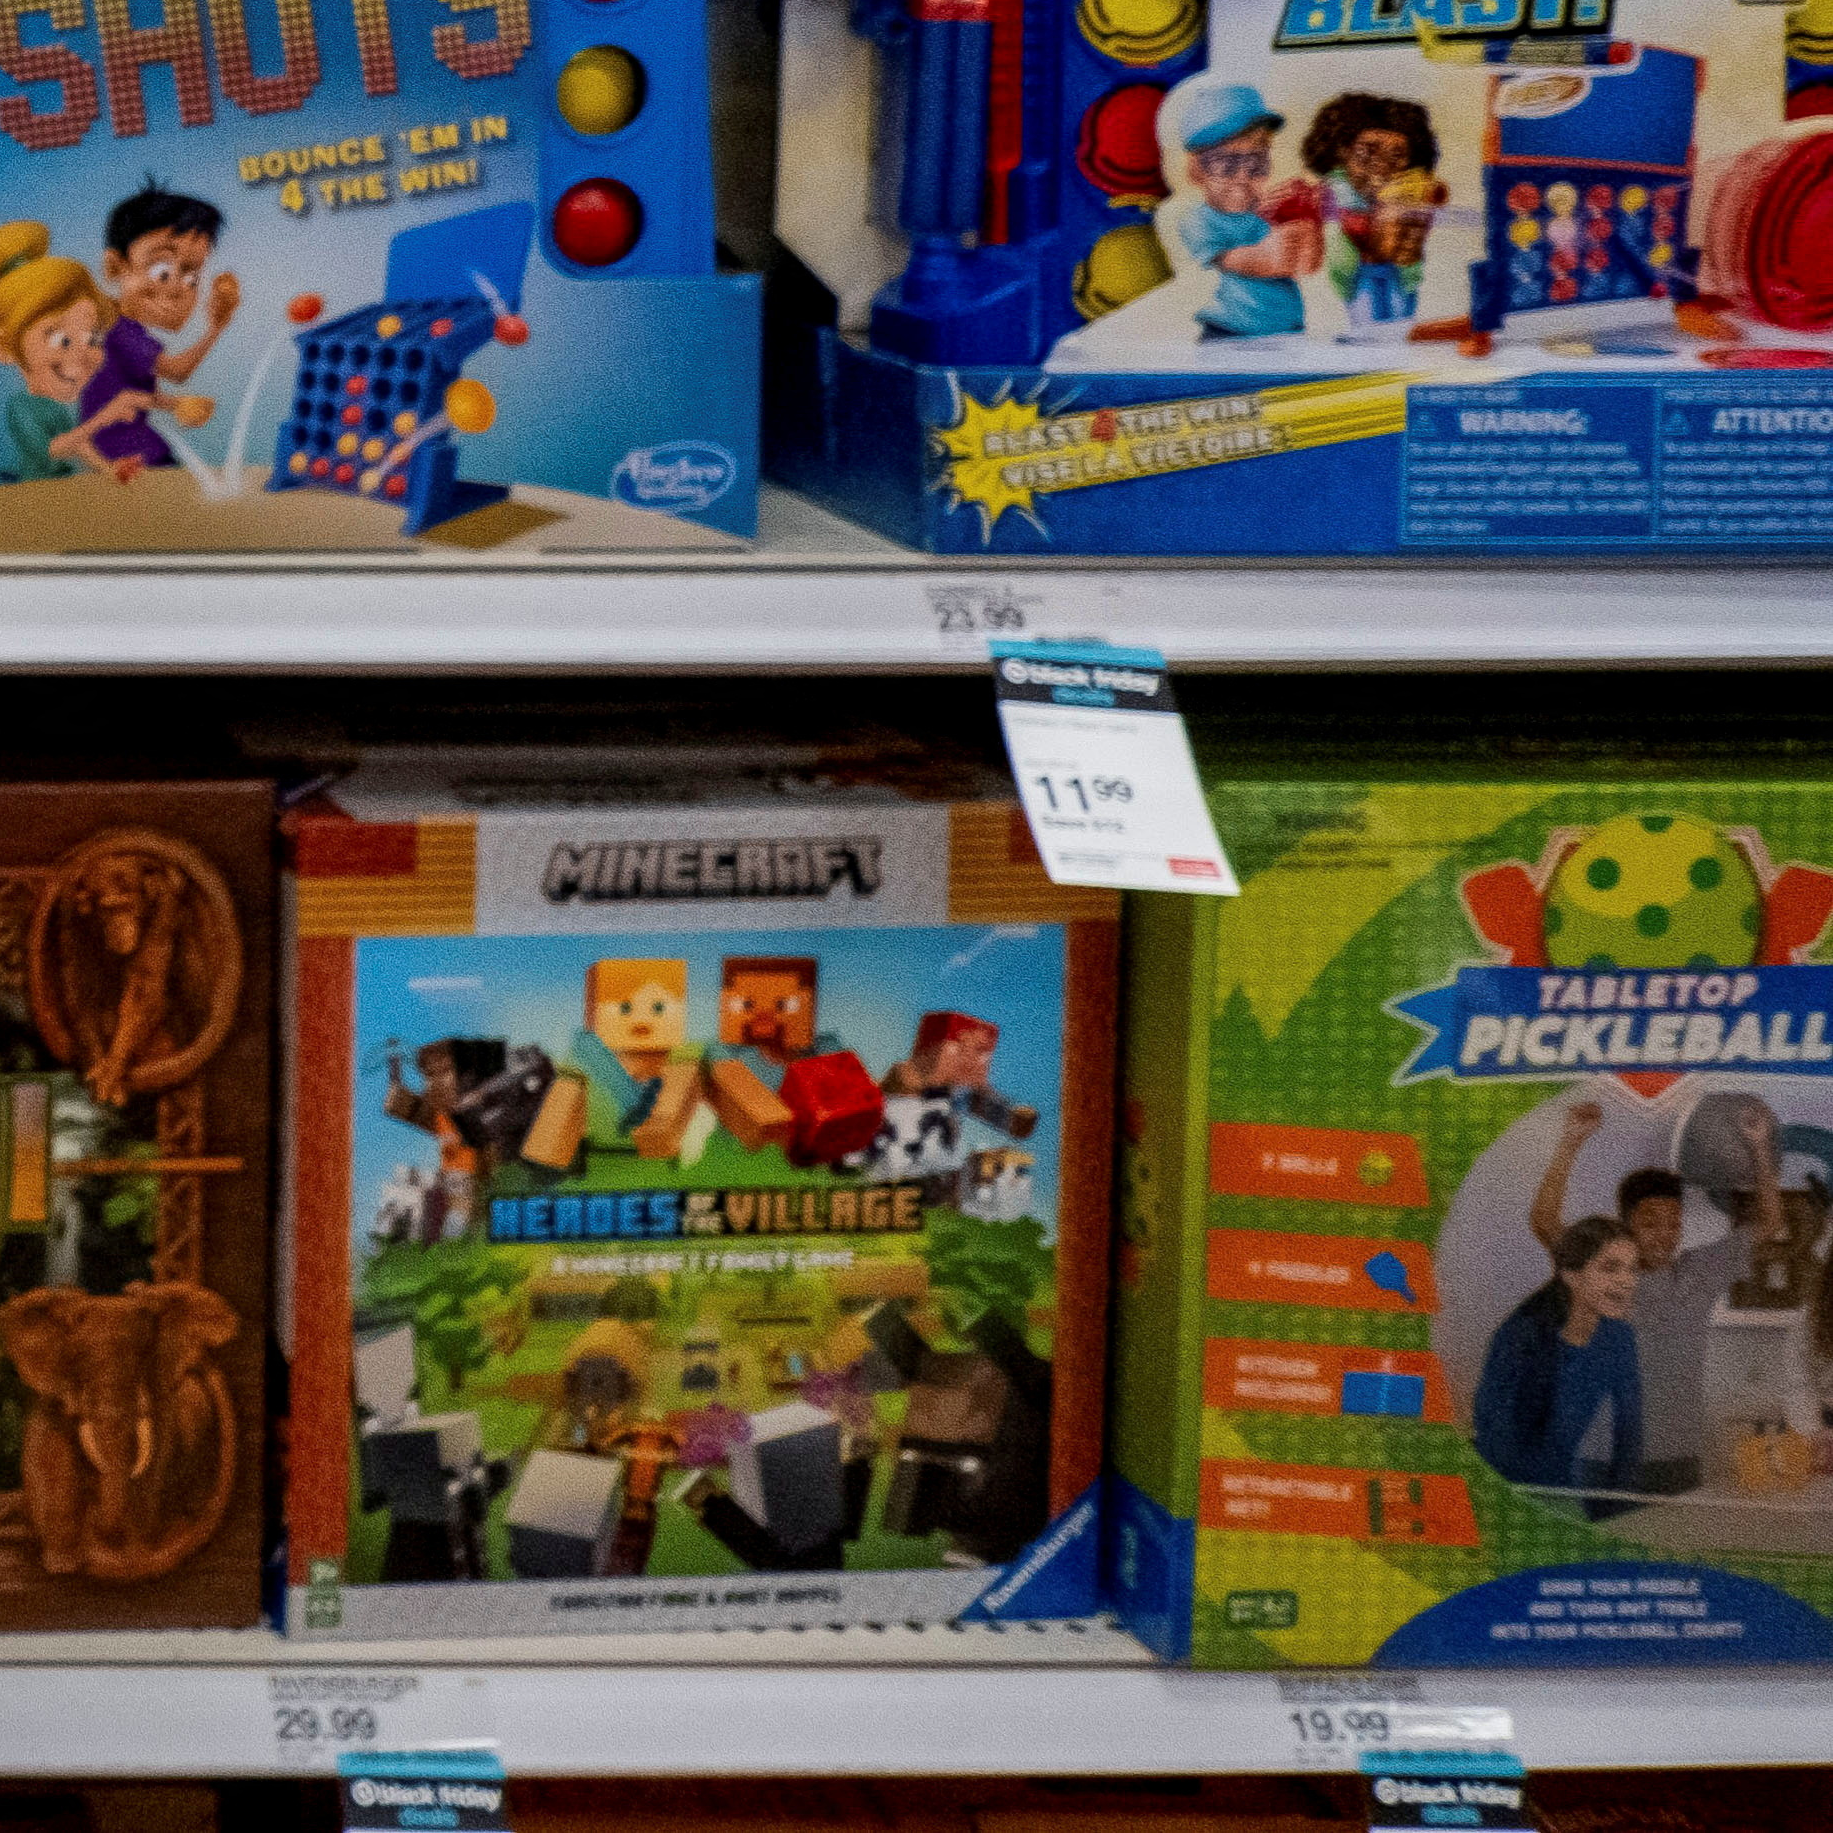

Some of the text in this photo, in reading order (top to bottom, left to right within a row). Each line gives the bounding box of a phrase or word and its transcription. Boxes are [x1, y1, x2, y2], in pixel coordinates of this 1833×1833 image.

[239, 133, 386, 184] BOUNCE
[470, 113, 509, 148] IN
[278, 158, 479, 217] 4 THE WIN!
[546, 838, 884, 903] MINECRAFT
[1538, 974, 1759, 1008] TABLETOP
[1460, 1015, 1833, 1066] PICKLEBALL
[725, 1185, 925, 1232] VILLAGE
[274, 1707, 377, 1741] 29.99
[1291, 1710, 1389, 1743] 19.99
